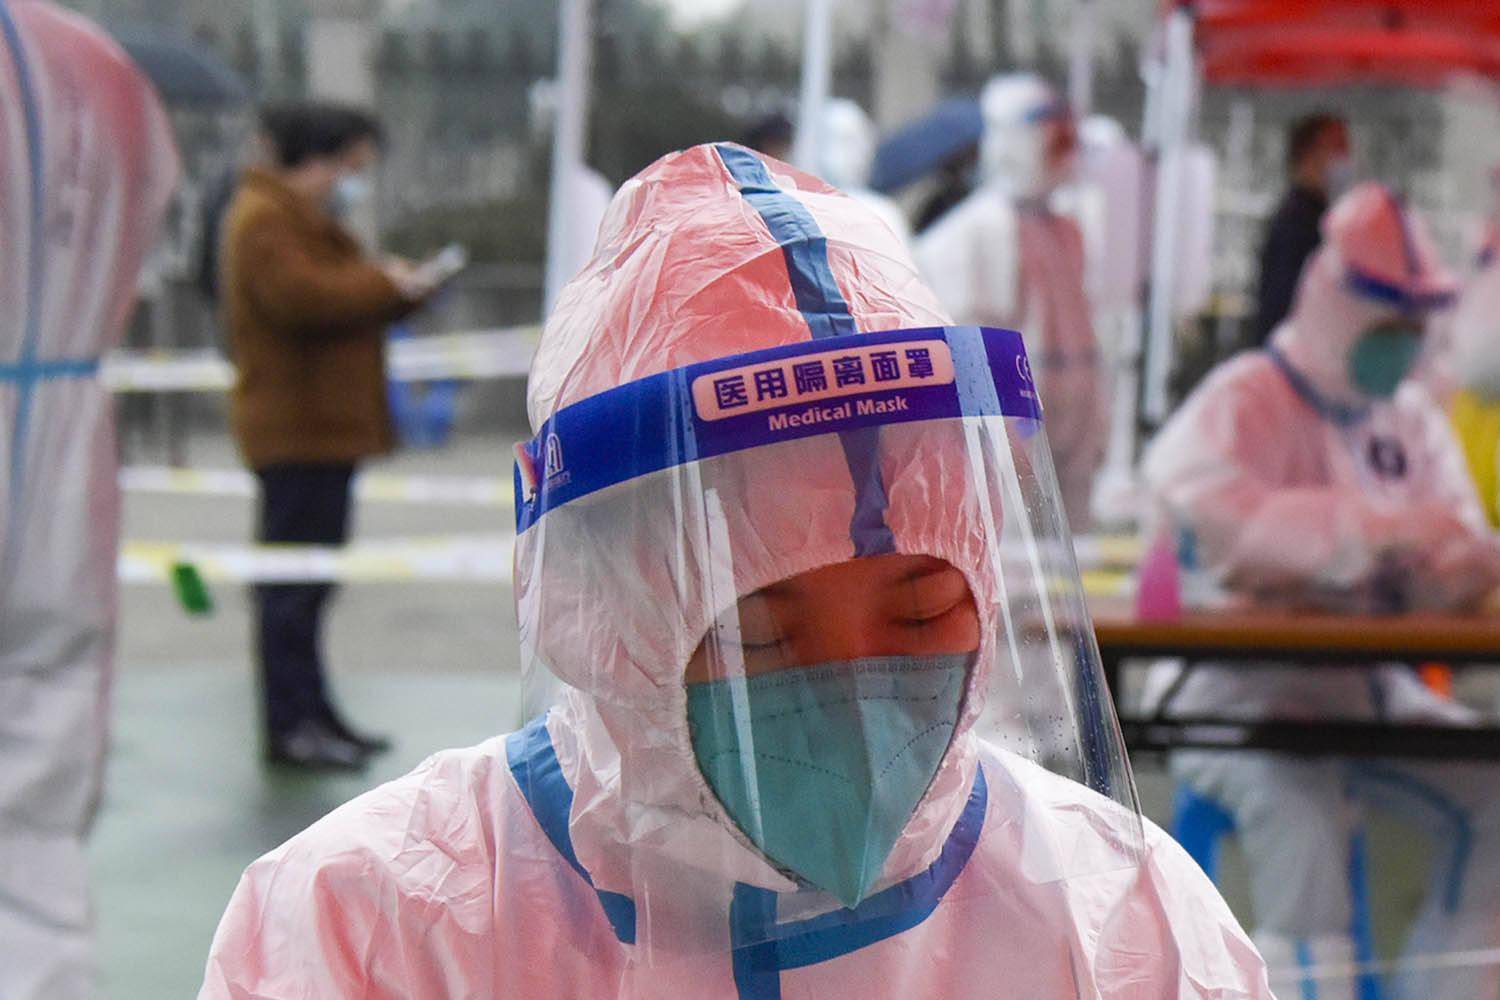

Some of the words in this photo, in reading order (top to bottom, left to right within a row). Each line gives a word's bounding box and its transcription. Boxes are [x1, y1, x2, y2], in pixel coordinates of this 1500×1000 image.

[713, 348, 935, 410] 医用隔离面罩
[768, 403, 851, 431] Medical
[857, 396, 909, 416] Mask
